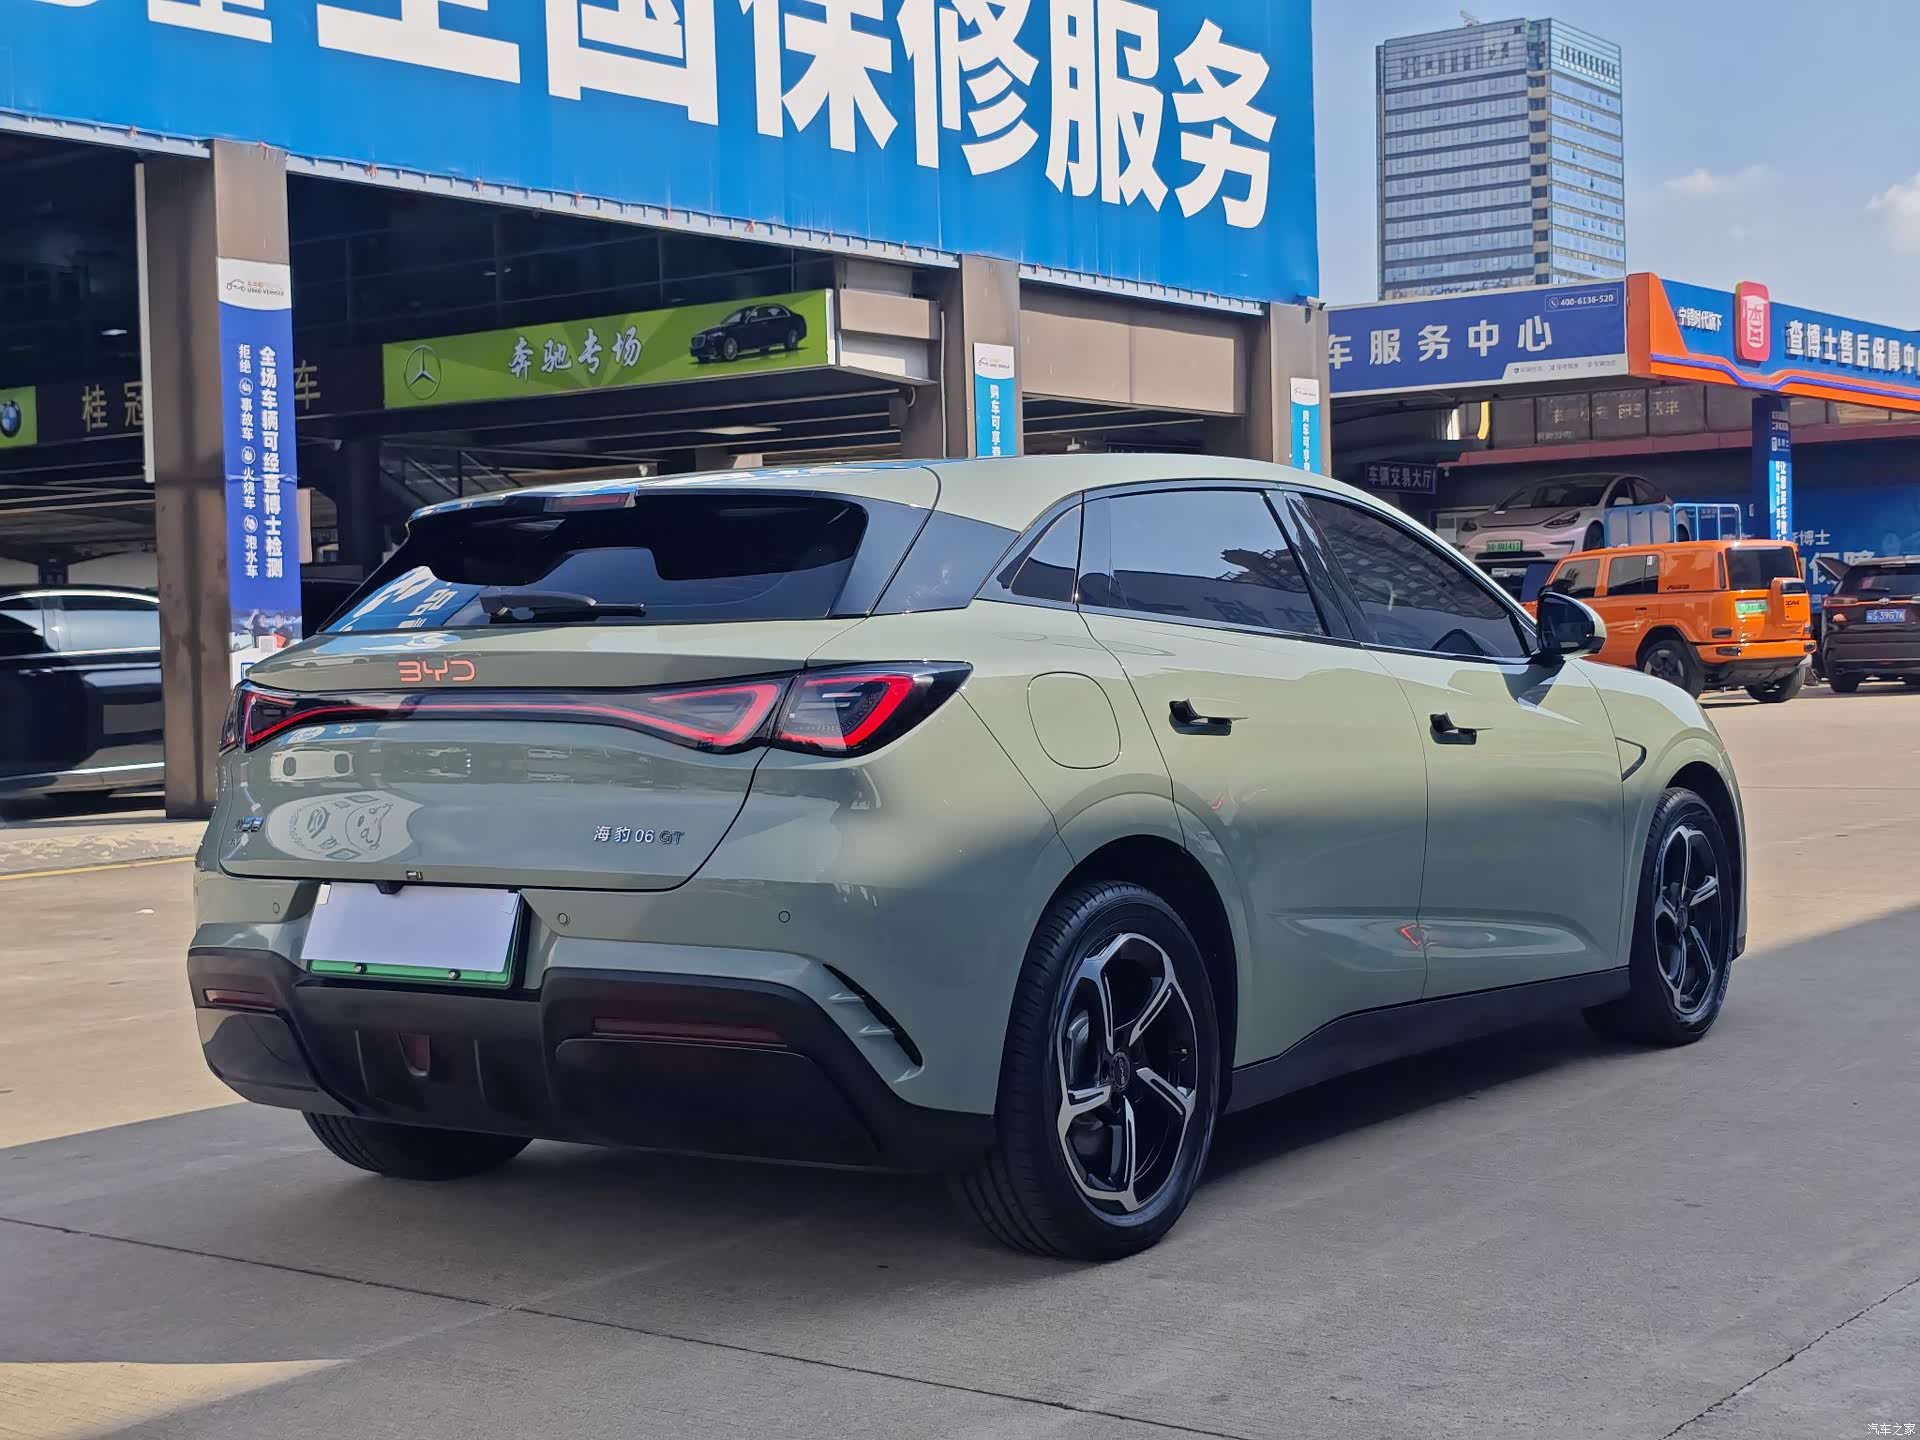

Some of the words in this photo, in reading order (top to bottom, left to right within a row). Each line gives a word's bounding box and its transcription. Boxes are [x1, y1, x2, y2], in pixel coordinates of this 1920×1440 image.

[1560, 294, 1614, 306] 400-6136-520
[1678, 306, 1722, 332] 宁德时代旗下
[239, 343, 251, 373] 拒绝
[509, 325, 642, 382] 奔驰专场
[1786, 320, 1920, 376] 查博士售后保障中
[240, 397, 254, 441] 事故车
[260, 346, 283, 578] 全场车辆可经查博士检测
[1368, 465, 1433, 489] 车辆交易大厅
[399, 660, 476, 682] BYD
[594, 826, 632, 842] 海豹
[635, 829, 655, 843] 06
[660, 830, 685, 845] GT
